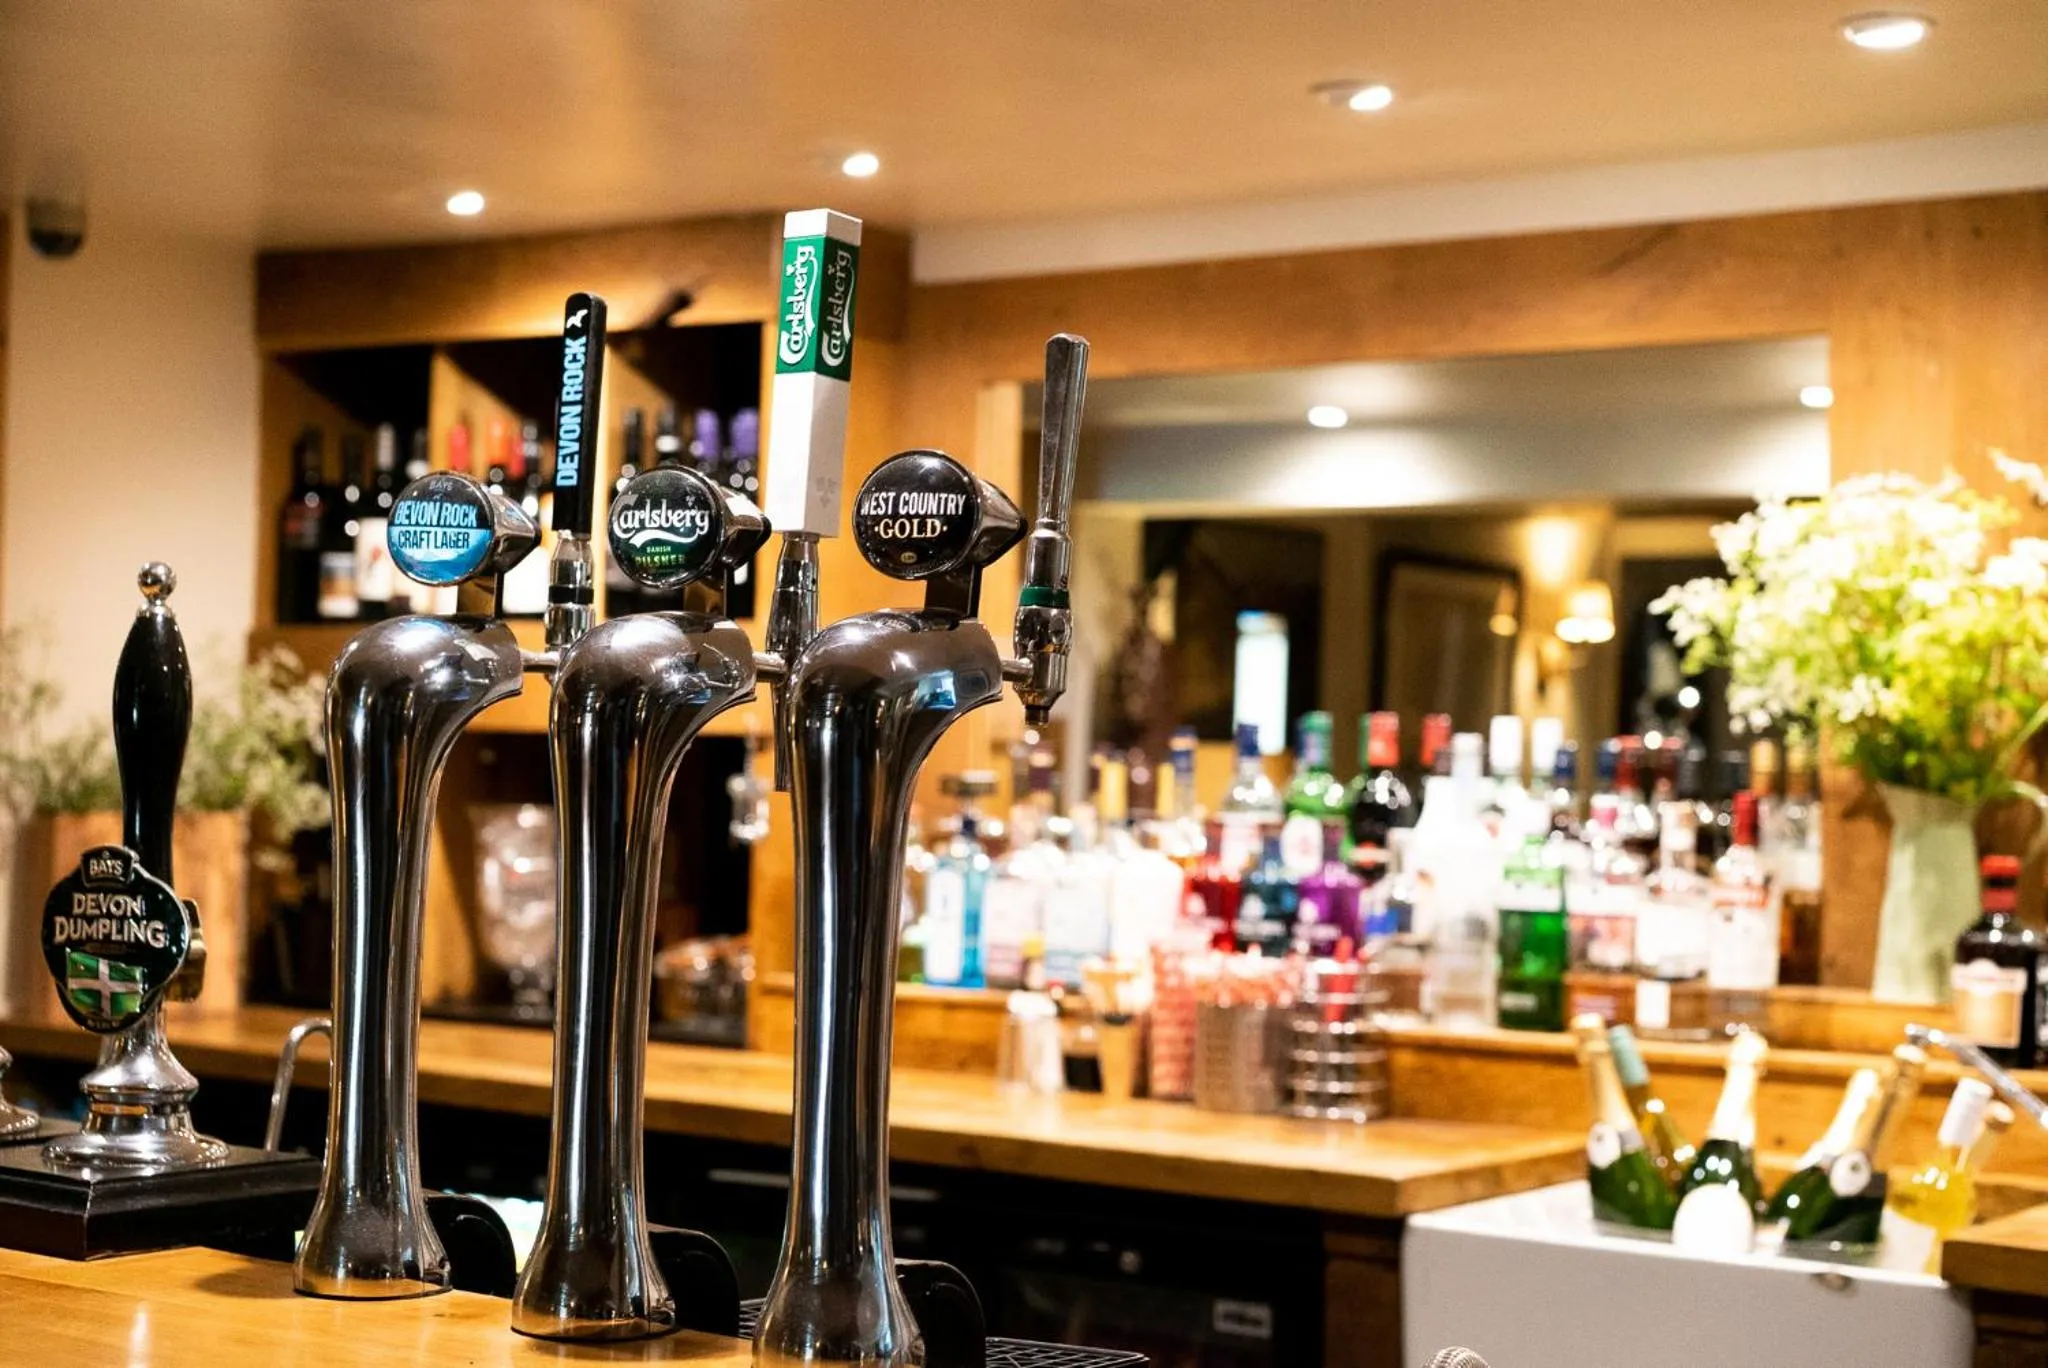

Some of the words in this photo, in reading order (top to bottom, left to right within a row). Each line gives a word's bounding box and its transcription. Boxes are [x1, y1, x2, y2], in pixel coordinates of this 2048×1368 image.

[779, 244, 819, 365] Carlsberg
[822, 249, 853, 367] Carlsberg
[561, 335, 587, 402] ROCK
[557, 404, 583, 487] DEVON
[394, 500, 438, 526] DEVON
[440, 502, 478, 528] ROCK
[613, 494, 710, 539] Carlsberg
[898, 491, 967, 516] COUNTRY
[398, 529, 432, 549] CRAFT
[434, 531, 470, 550] LAGER
[879, 518, 942, 539] GOLD
[634, 554, 686, 567] PILSNER
[646, 545, 672, 553] DANISH
[89, 857, 124, 876] BAYS
[72, 892, 143, 917] DEVON
[53, 917, 166, 949] DUMPLING
